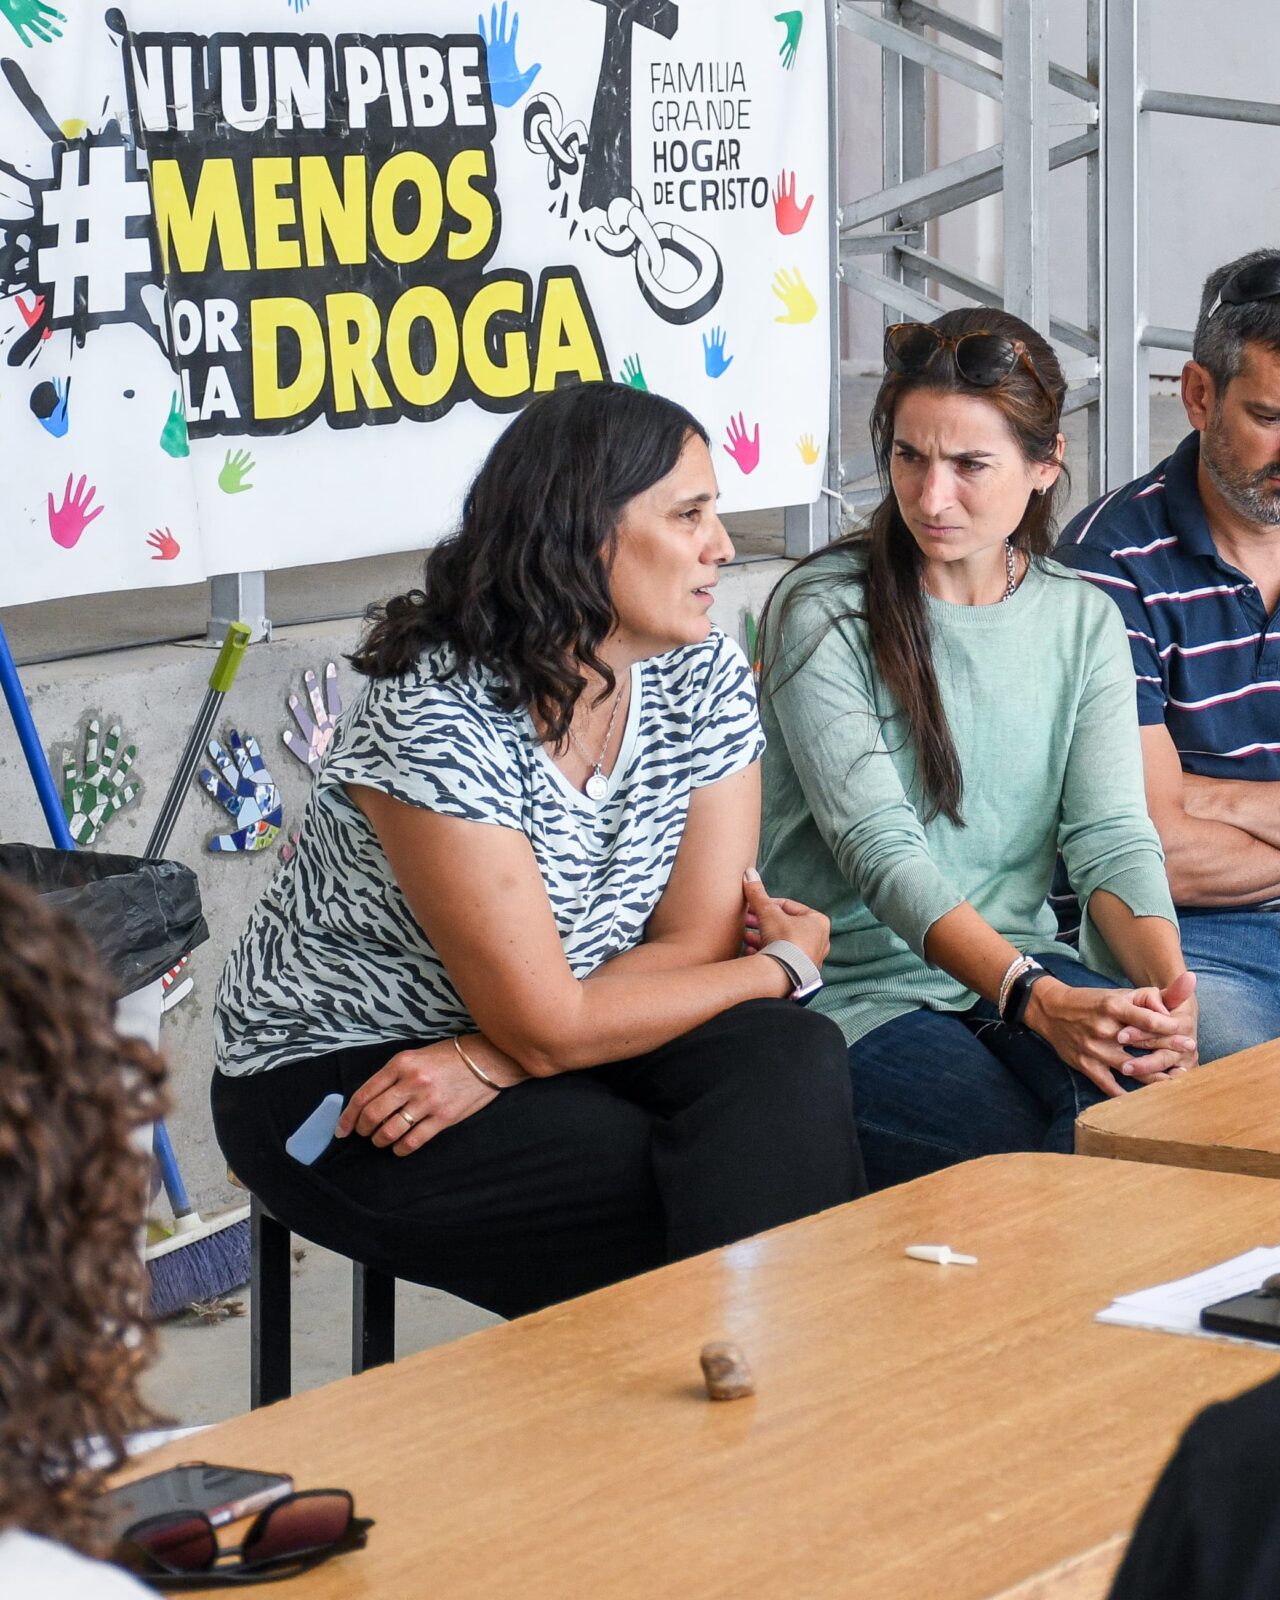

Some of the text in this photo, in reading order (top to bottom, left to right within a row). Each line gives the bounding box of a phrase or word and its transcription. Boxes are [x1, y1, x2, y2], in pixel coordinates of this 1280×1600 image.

[131, 46, 487, 132] NI UN PIBE
[650, 61, 747, 94] FAMILIA
[652, 99, 752, 132] GRANDE
[653, 139, 741, 173] HOGAR
[152, 150, 494, 274] MENOS
[653, 176, 769, 212] DE CRISTO
[171, 298, 243, 356] OR
[249, 277, 605, 420] DROGA
[181, 365, 241, 422] LA
